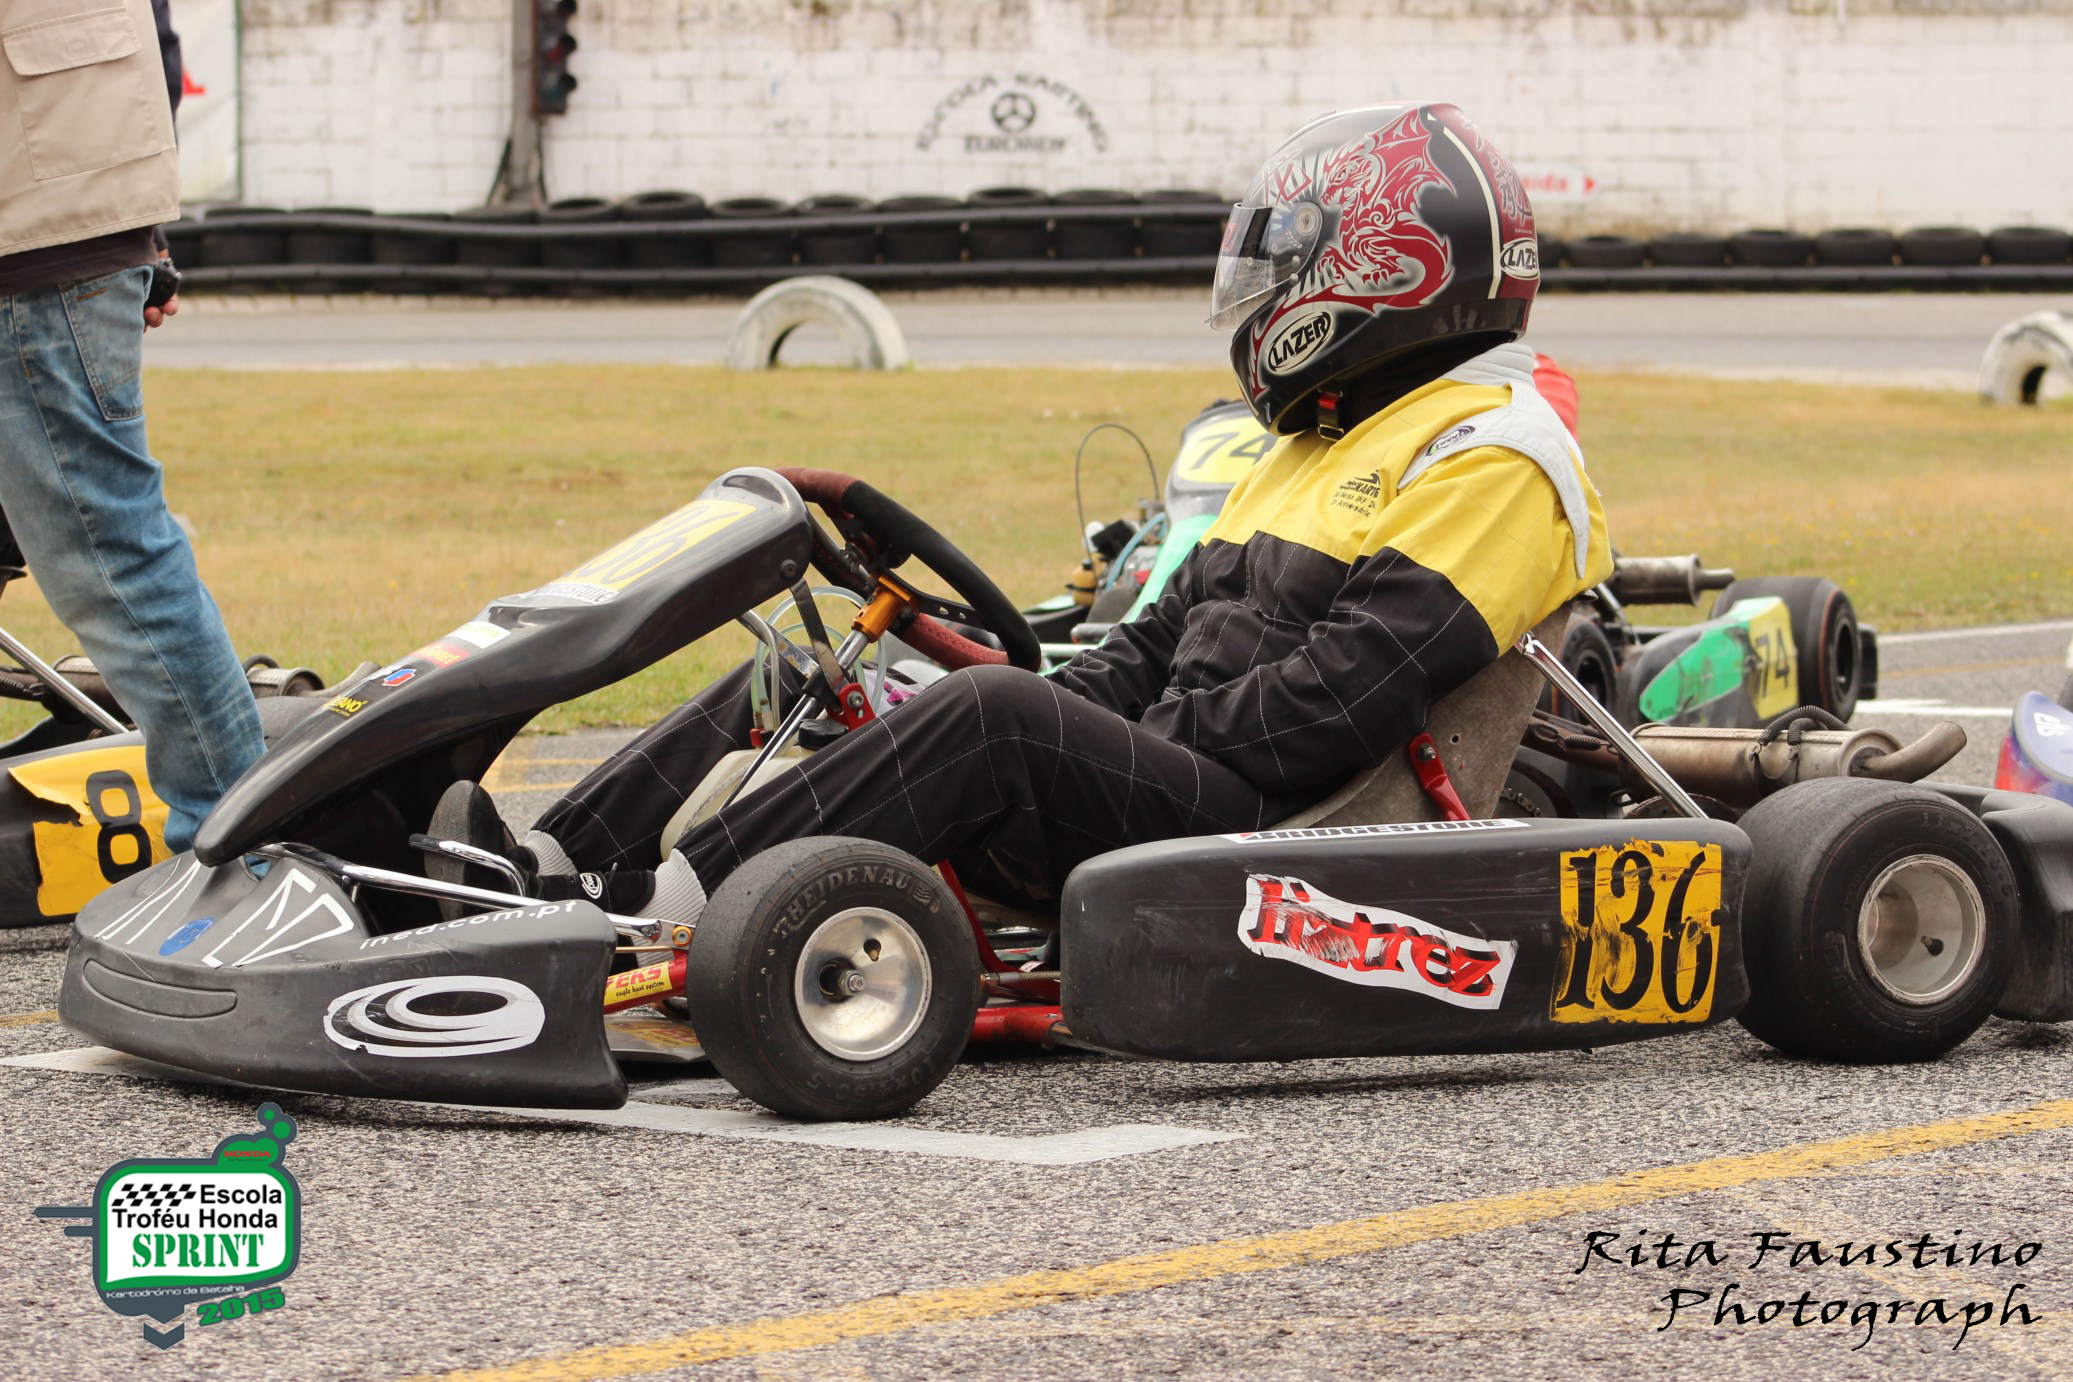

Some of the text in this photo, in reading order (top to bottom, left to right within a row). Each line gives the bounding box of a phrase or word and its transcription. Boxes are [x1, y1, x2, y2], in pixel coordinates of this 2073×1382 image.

[1506, 248, 1538, 270] LAZE
[1271, 314, 1330, 368] LAZER
[1190, 431, 1266, 471] 74
[1753, 626, 1792, 699] 74
[86, 769, 152, 884] 8
[1240, 818, 1507, 841] BRIDGESTONE
[784, 865, 912, 922] HEIDENAU
[1555, 848, 1714, 1013] 136
[615, 980, 665, 997] eagle kart system
